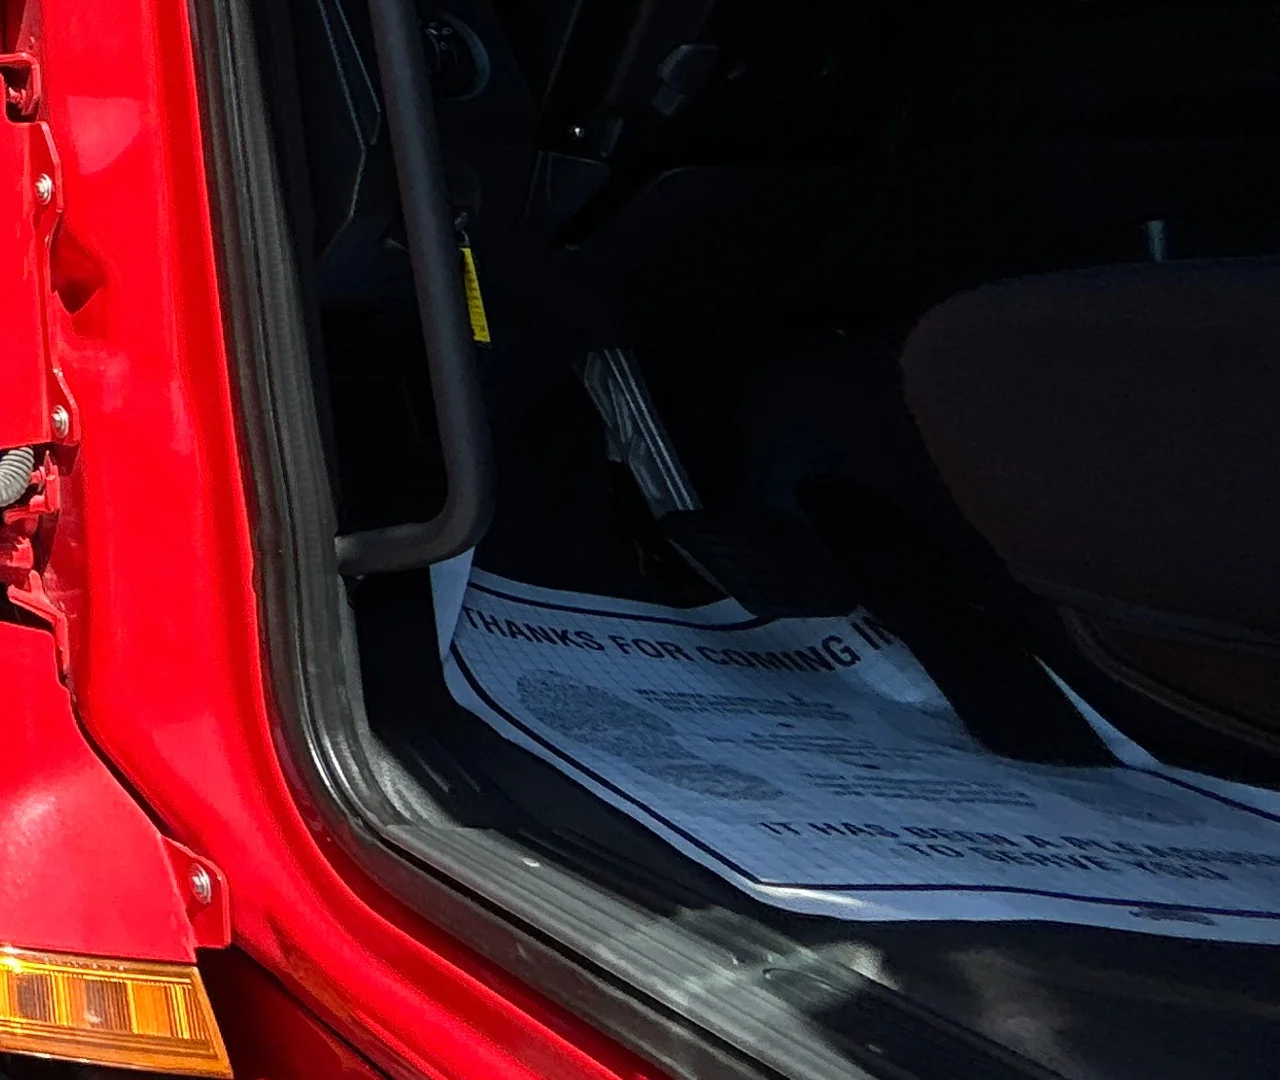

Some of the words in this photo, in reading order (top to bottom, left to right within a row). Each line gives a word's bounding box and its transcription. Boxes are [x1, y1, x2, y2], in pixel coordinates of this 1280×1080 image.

[461, 605, 605, 652] THANKS
[608, 634, 696, 662] FOR
[696, 635, 861, 671] COMING
[760, 821, 801, 835] IT
[807, 822, 900, 838] HAS
[1023, 834, 1062, 849] A
[899, 842, 965, 858] TO
[967, 846, 1122, 873] SERVE
